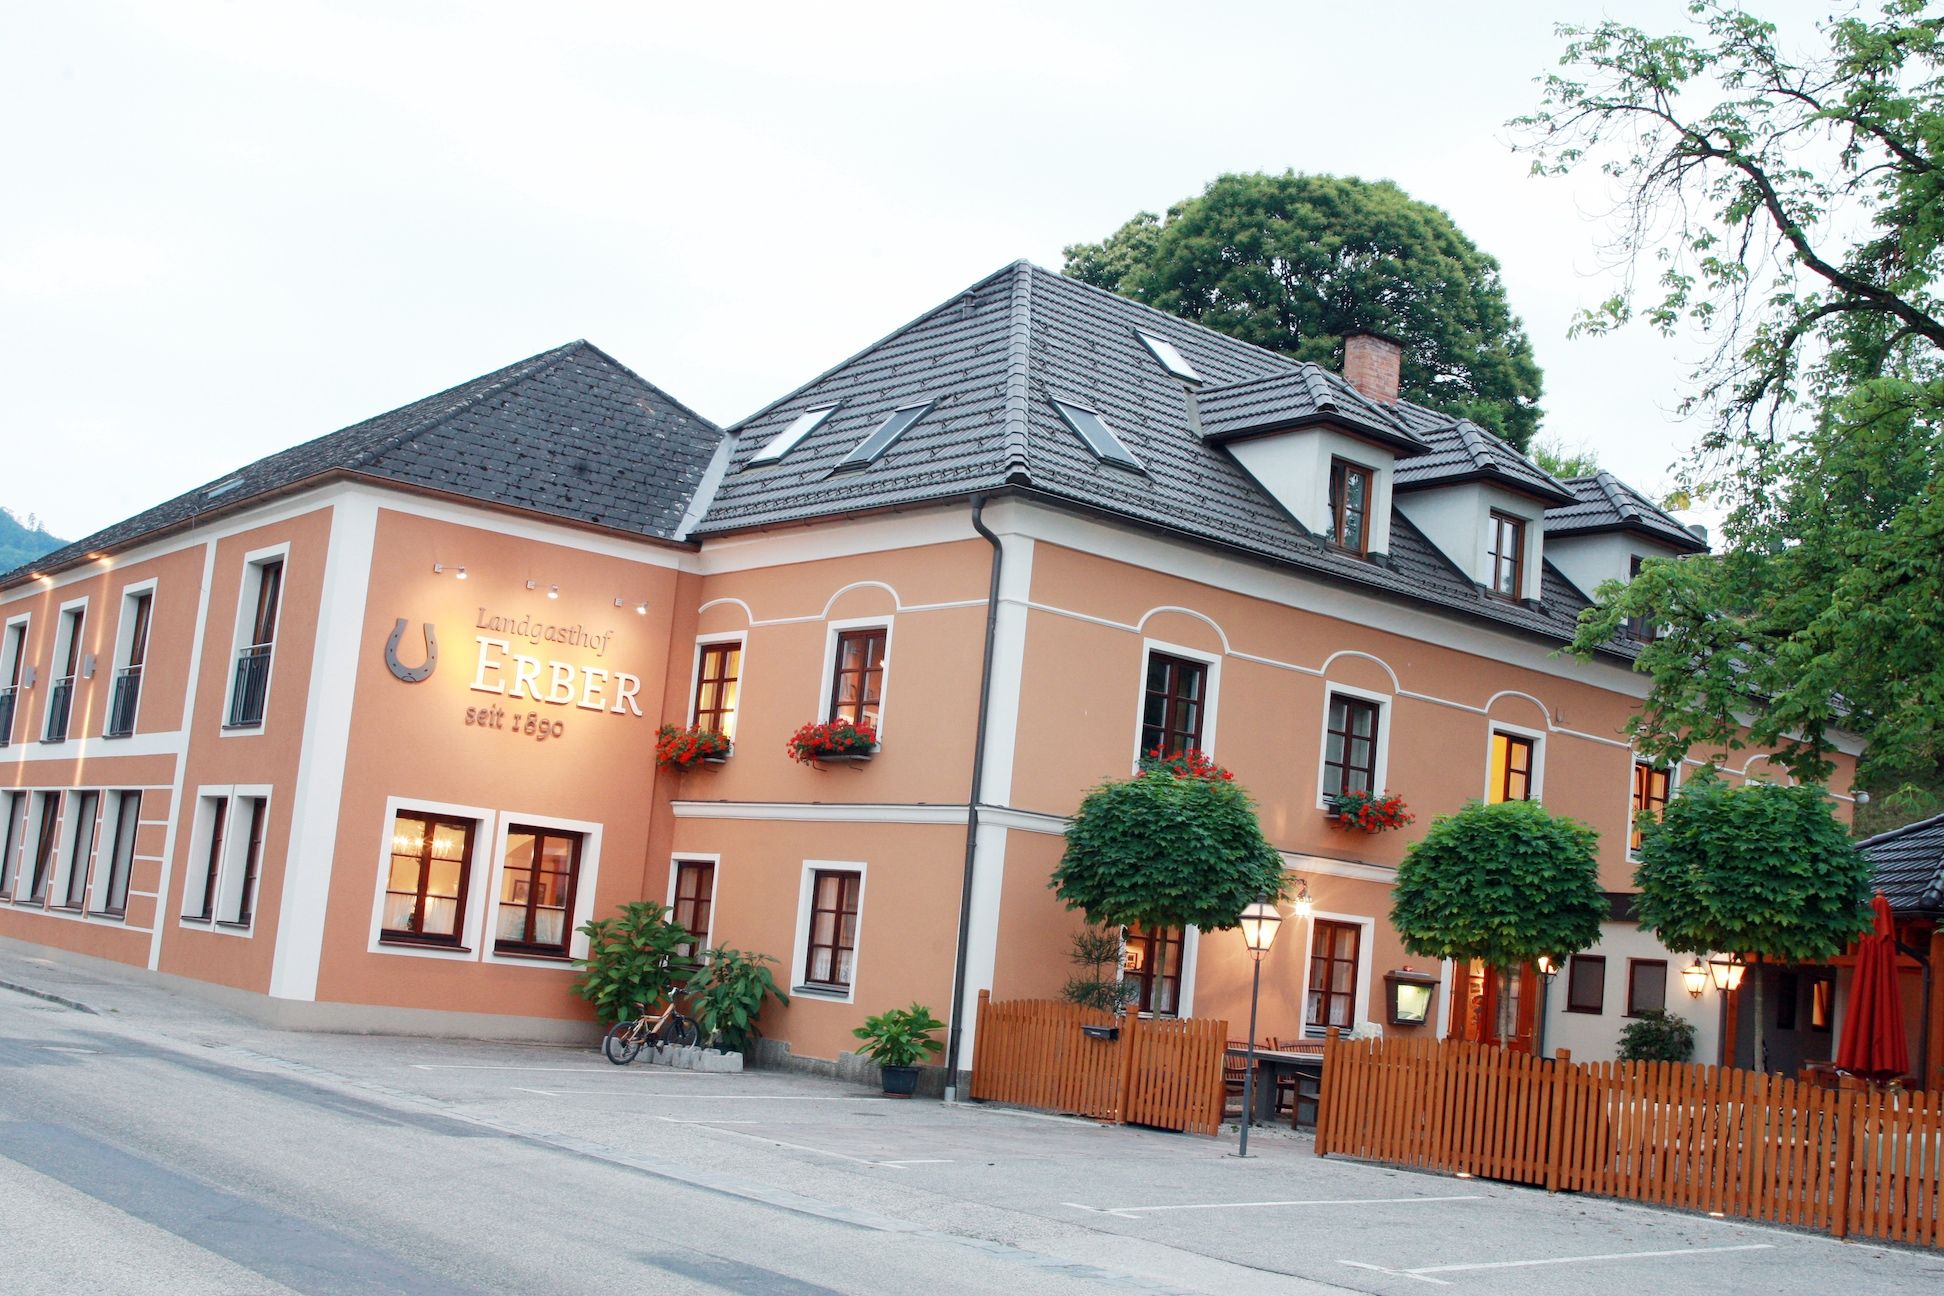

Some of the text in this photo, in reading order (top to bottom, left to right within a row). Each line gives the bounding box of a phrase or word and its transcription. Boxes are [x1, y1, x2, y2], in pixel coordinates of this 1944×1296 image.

[475, 607, 614, 656] Landgasthof
[470, 635, 643, 717] ERBER
[464, 704, 564, 741] seit 1890
